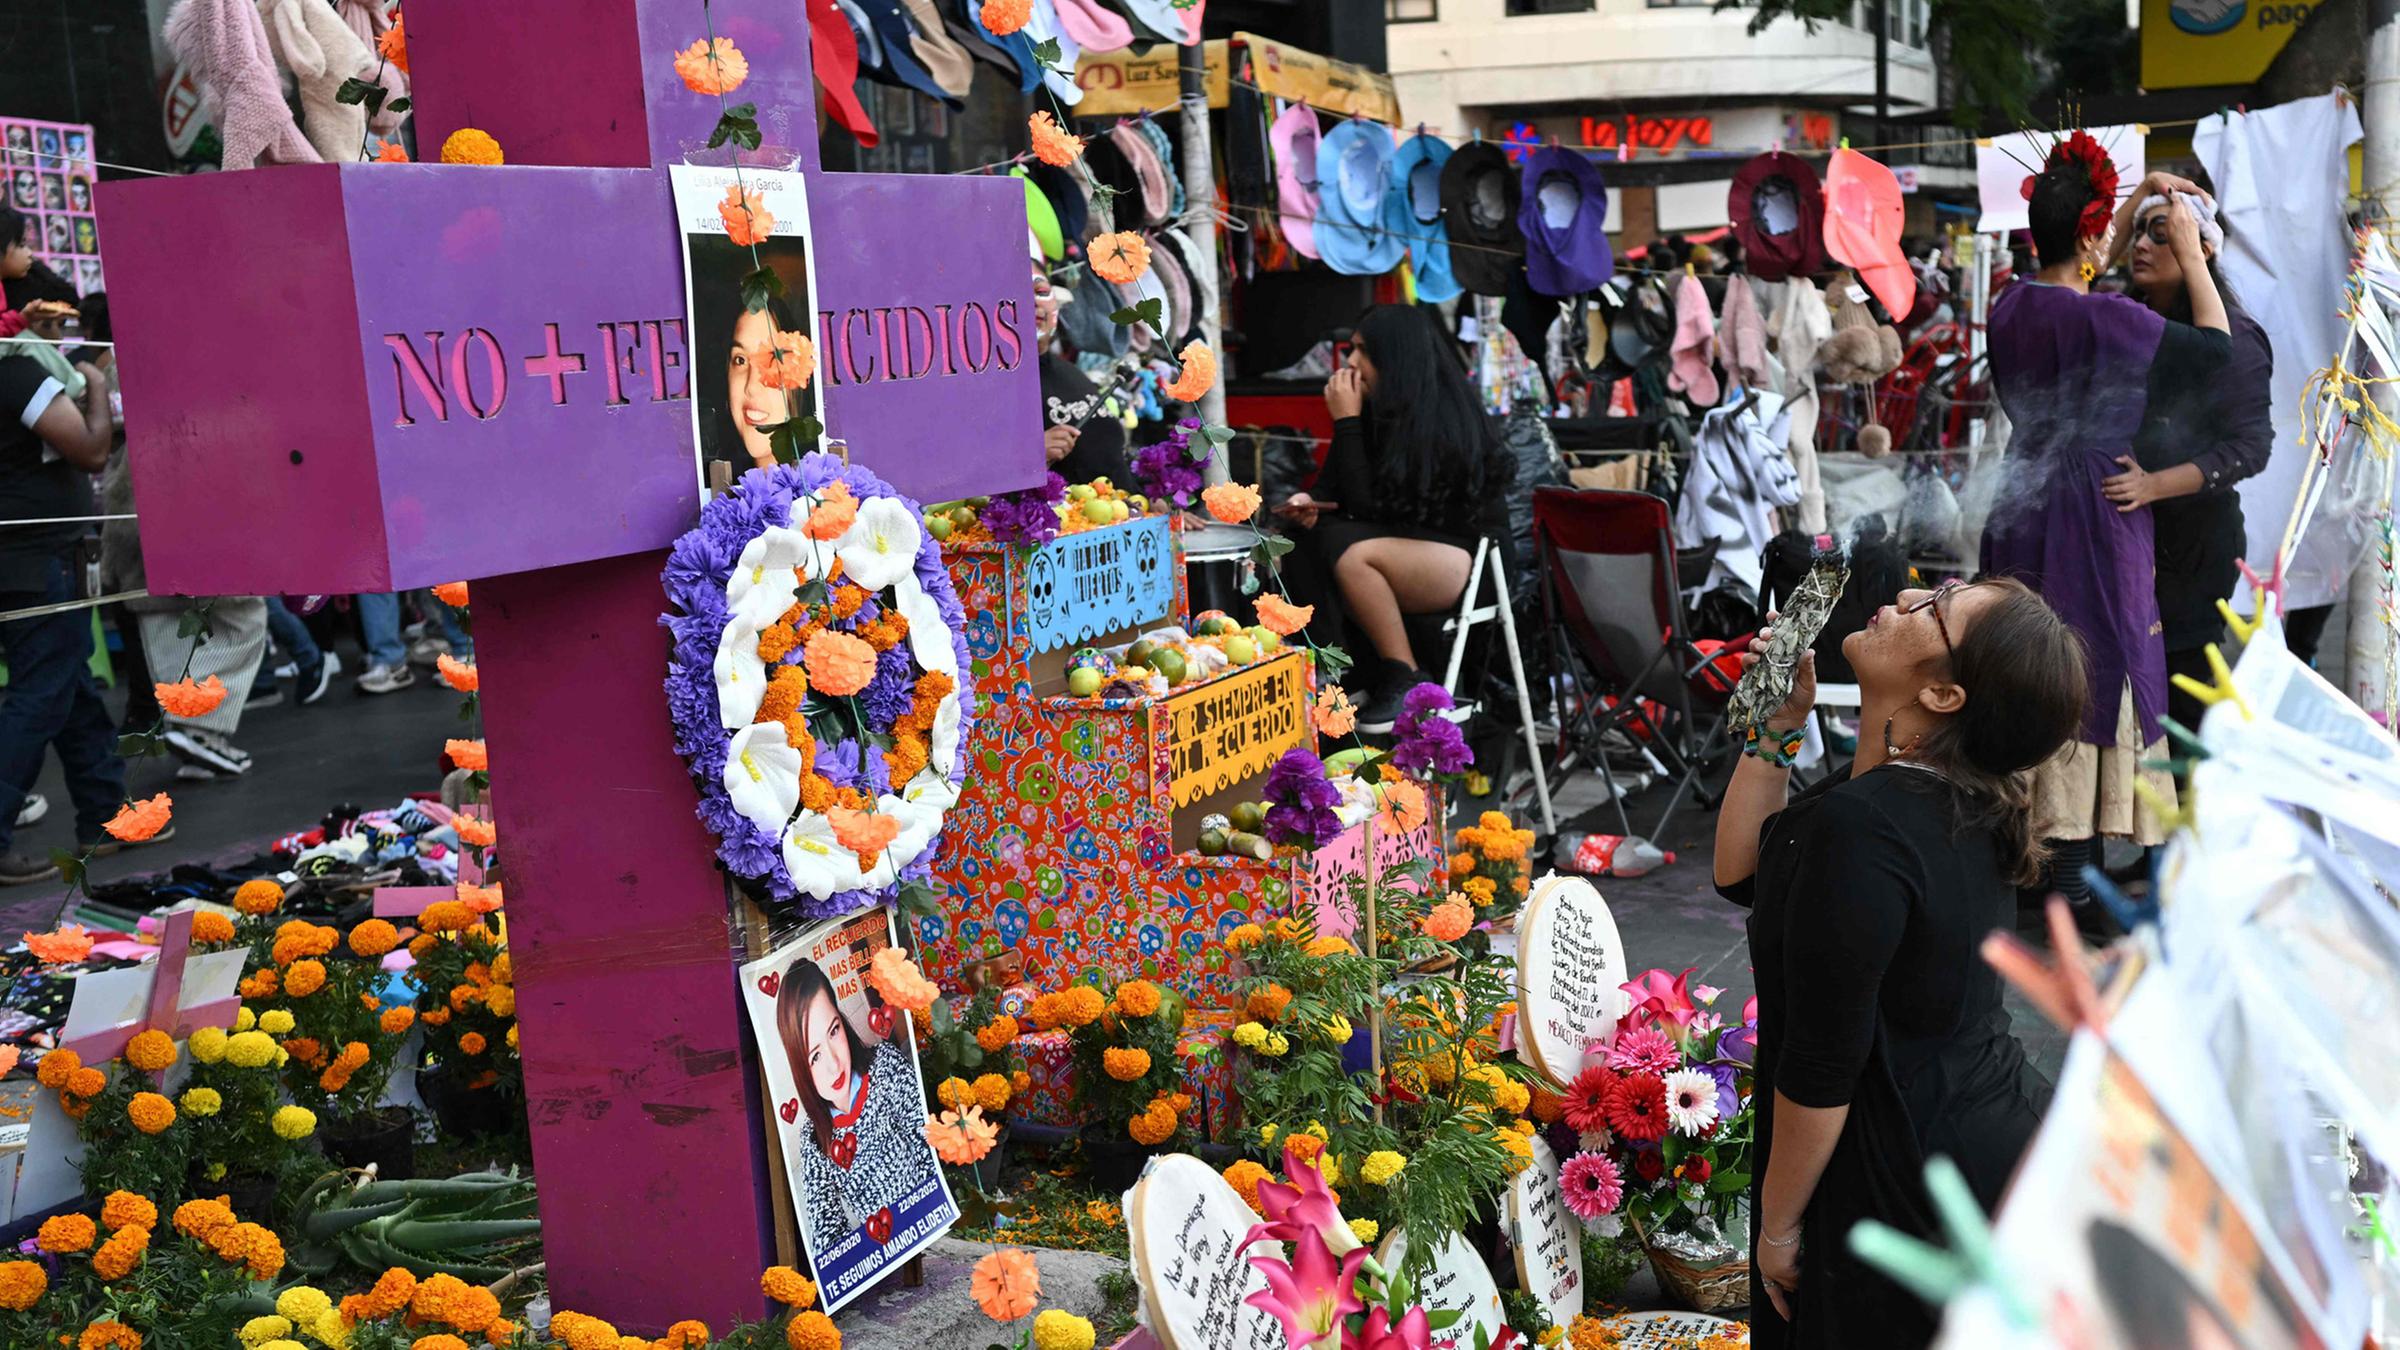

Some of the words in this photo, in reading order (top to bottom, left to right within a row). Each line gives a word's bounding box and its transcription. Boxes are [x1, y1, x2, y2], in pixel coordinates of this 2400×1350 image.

[1624, 113, 1713, 159] joya
[384, 326, 508, 428] NO
[597, 298, 1022, 408] FEICIDIOS
[1169, 706, 1199, 744] POR
[1204, 679, 1269, 731] SIEMPRE
[1275, 667, 1294, 703] EN
[1169, 742, 1193, 782] MI
[1200, 701, 1296, 769] RECUERDO
[812, 943, 825, 962] EL
[825, 913, 888, 954] RECUERDO
[828, 960, 848, 980] MAS
[848, 943, 878, 972] BELLO
[836, 978, 858, 1000] MAS
[897, 1178, 939, 1214] 22/06/2025
[817, 1232, 862, 1270] 22/06/2020
[825, 1281, 841, 1300] TE
[838, 1250, 884, 1292] SEGUIMOS
[882, 1225, 919, 1261] AMANDO
[916, 1202, 952, 1236] ELIDETH
